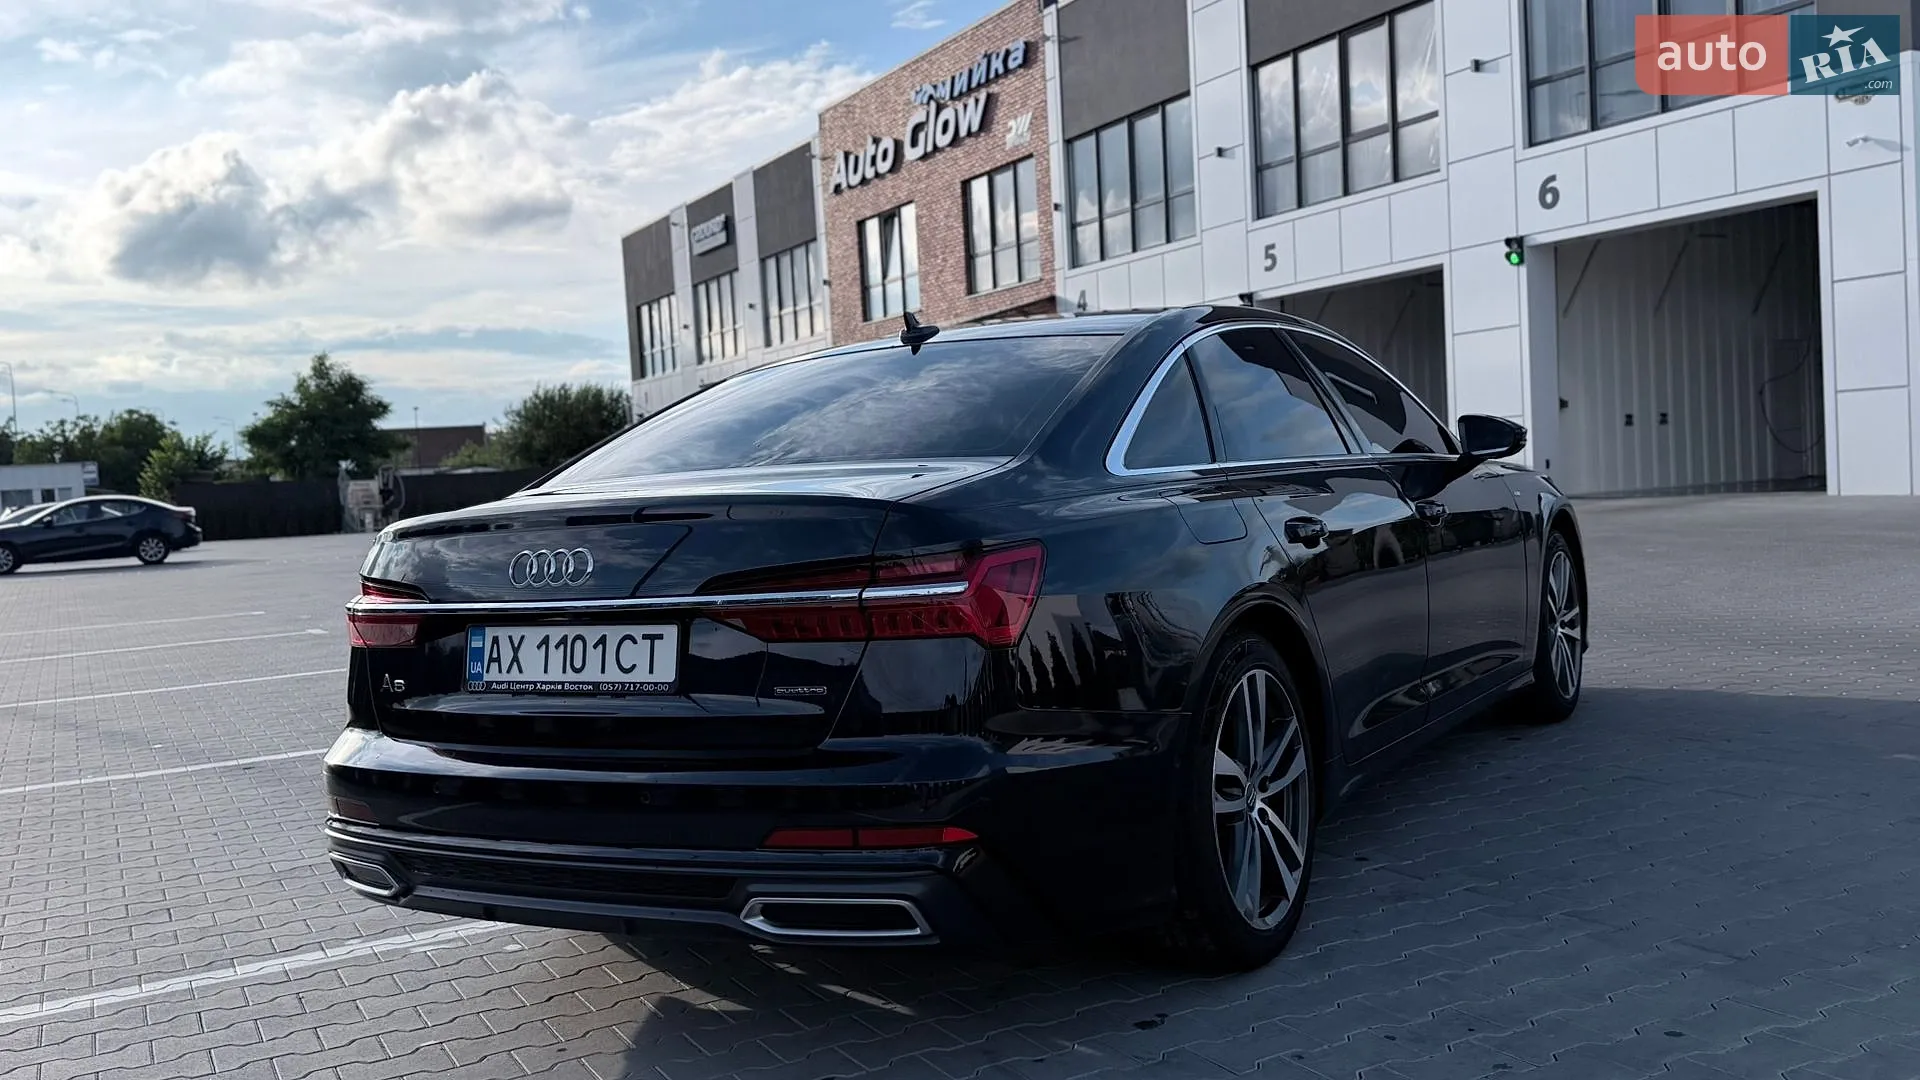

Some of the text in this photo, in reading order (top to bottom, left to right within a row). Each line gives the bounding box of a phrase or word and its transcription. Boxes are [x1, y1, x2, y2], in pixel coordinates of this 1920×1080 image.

[831, 91, 988, 192] Auto Glow
[1538, 174, 1560, 210] 6
[1264, 243, 1279, 272] 5
[1077, 289, 1088, 312] 4
[470, 661, 482, 673] UA
[485, 634, 526, 674] AX
[490, 682, 509, 690] Audi
[510, 682, 535, 692] Центр
[564, 682, 594, 691] Восток
[624, 683, 669, 692] 717-00-00
